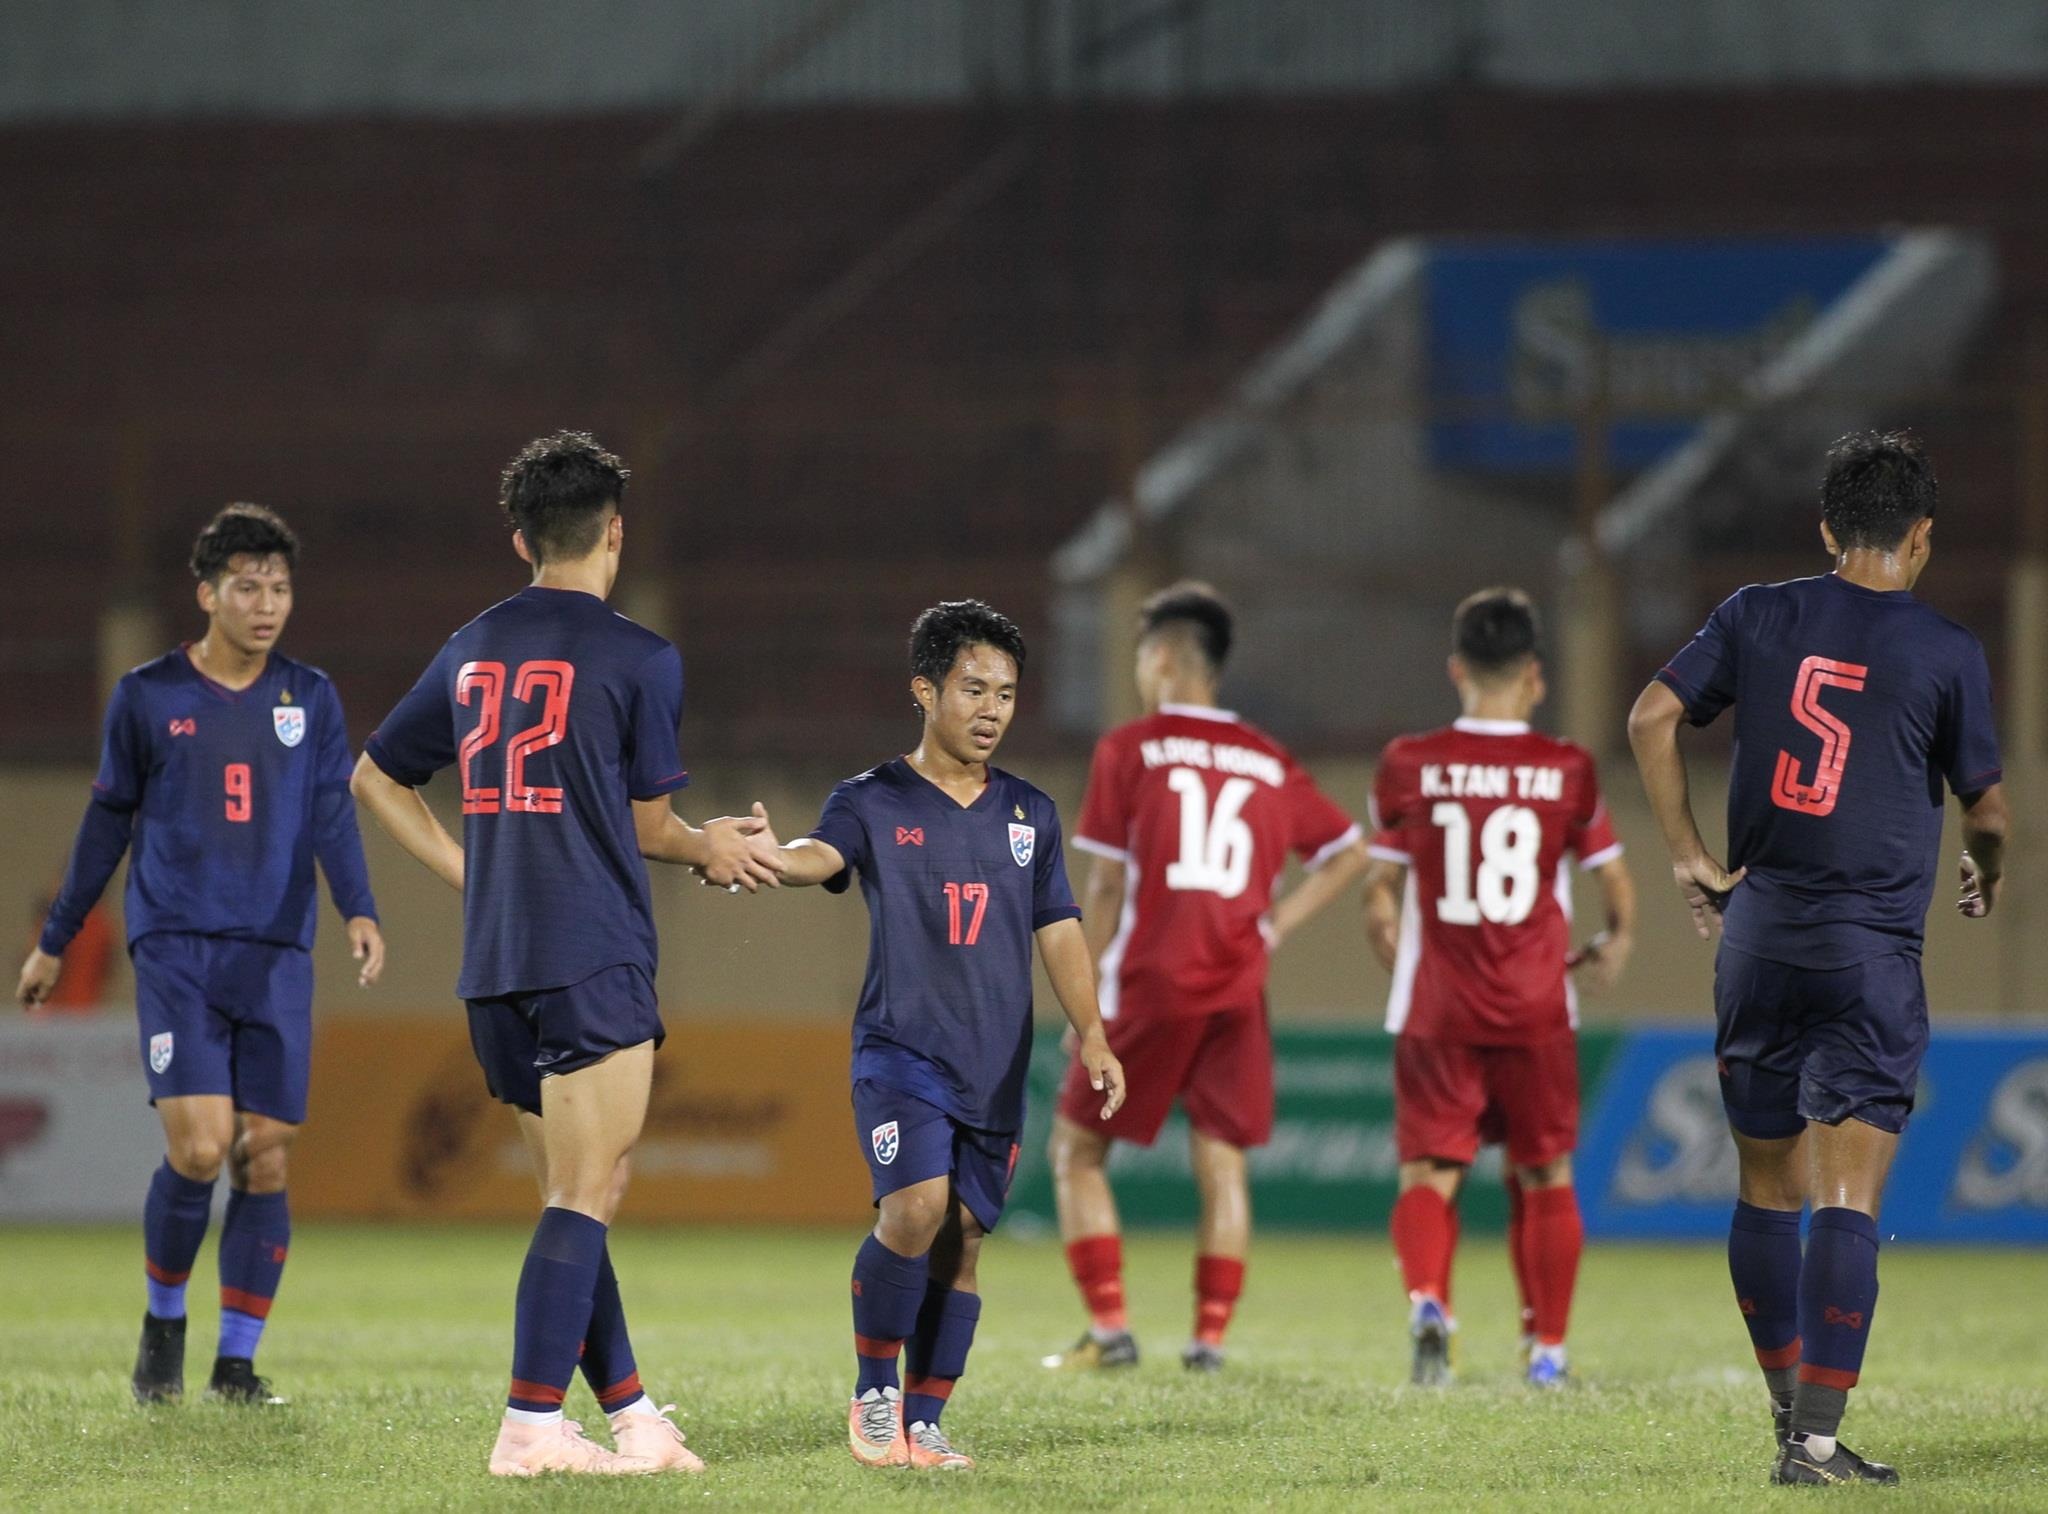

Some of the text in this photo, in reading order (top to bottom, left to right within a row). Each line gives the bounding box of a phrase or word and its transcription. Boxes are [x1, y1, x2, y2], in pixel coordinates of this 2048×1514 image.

[224, 764, 252, 822] 9
[456, 660, 575, 814] 22
[1770, 655, 1868, 817] 5
[1166, 767, 1254, 898] 16
[1431, 801, 1542, 926] 18
[943, 882, 989, 945] 17
